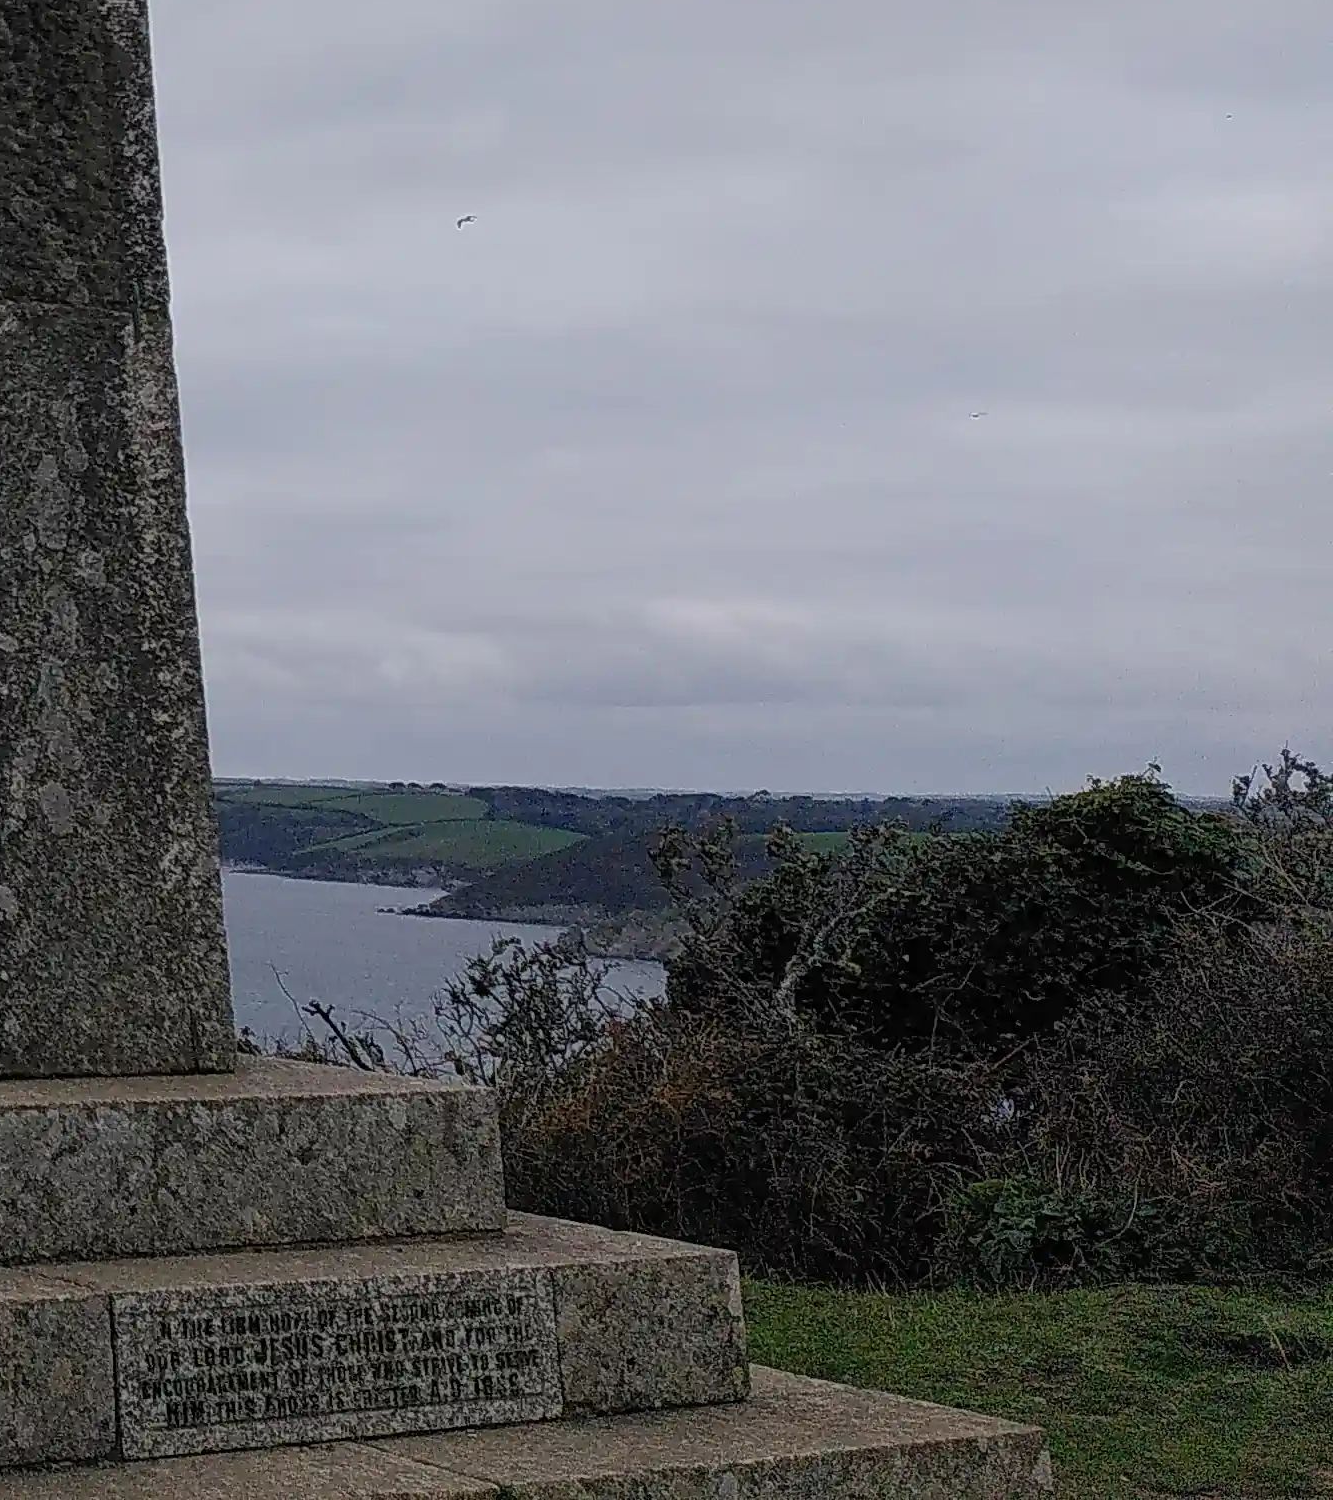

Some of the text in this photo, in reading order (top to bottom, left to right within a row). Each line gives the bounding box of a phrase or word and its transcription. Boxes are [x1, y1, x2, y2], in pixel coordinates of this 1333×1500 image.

[181, 1317, 214, 1340] THE
[144, 1350, 180, 1372] OUR
[193, 1346, 244, 1368] LORD
[253, 1333, 324, 1366] JESUS
[421, 1328, 455, 1351] AND
[464, 1326, 495, 1347] FOR
[504, 1323, 534, 1344] THE
[469, 1352, 489, 1372] TO
